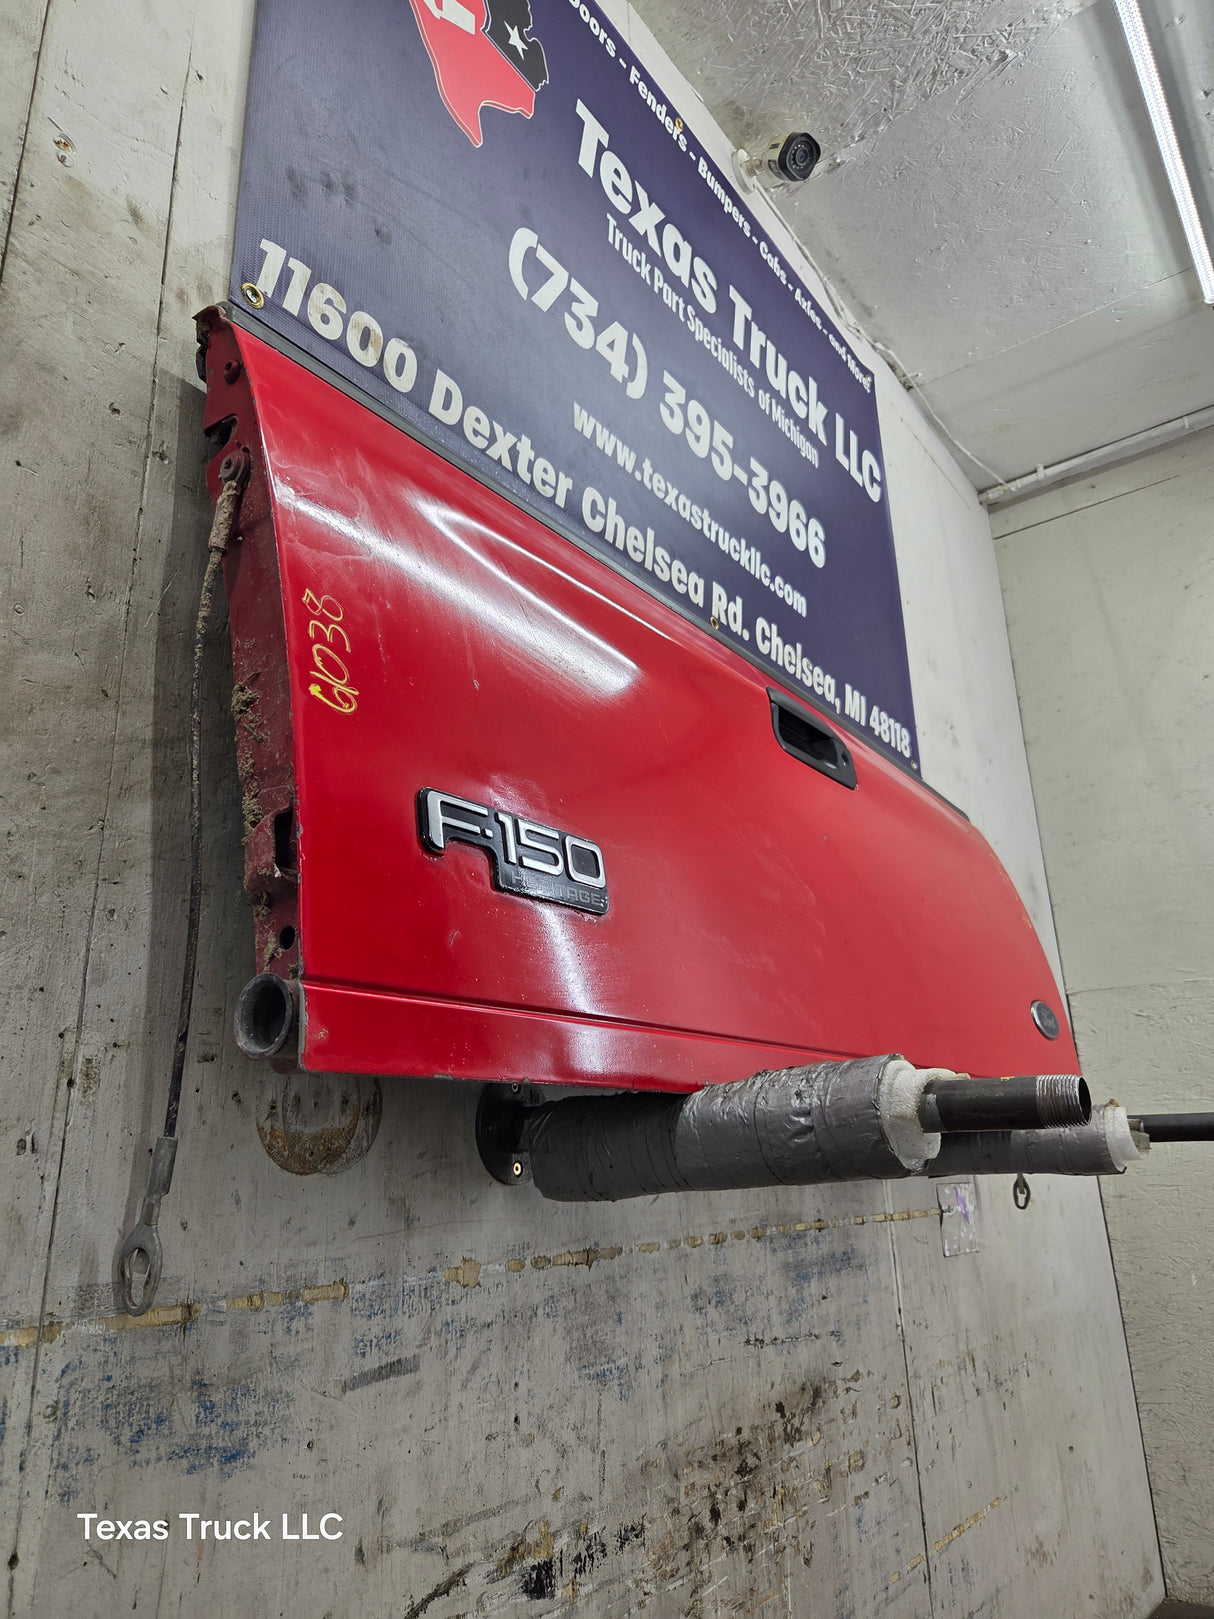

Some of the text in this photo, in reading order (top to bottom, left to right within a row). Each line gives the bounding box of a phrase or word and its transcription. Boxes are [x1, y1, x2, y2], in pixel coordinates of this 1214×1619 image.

[576, 99, 881, 502] Texas Truck LLC
[607, 213, 651, 286] Truck
[654, 266, 685, 322] Part
[687, 305, 755, 398] Specialists
[771, 398, 819, 468] Michigan
[630, 66, 688, 152] Fenders
[698, 157, 751, 237] Bumpers
[760, 241, 787, 285] Cabs
[794, 288, 822, 330] Axles
[256, 239, 912, 758] 11600 Dexter Chelsea Rd. Chelsea, MI 48118
[509, 227, 826, 568] (734) 395-3966
[573, 402, 807, 617] www.texastruckllc.com
